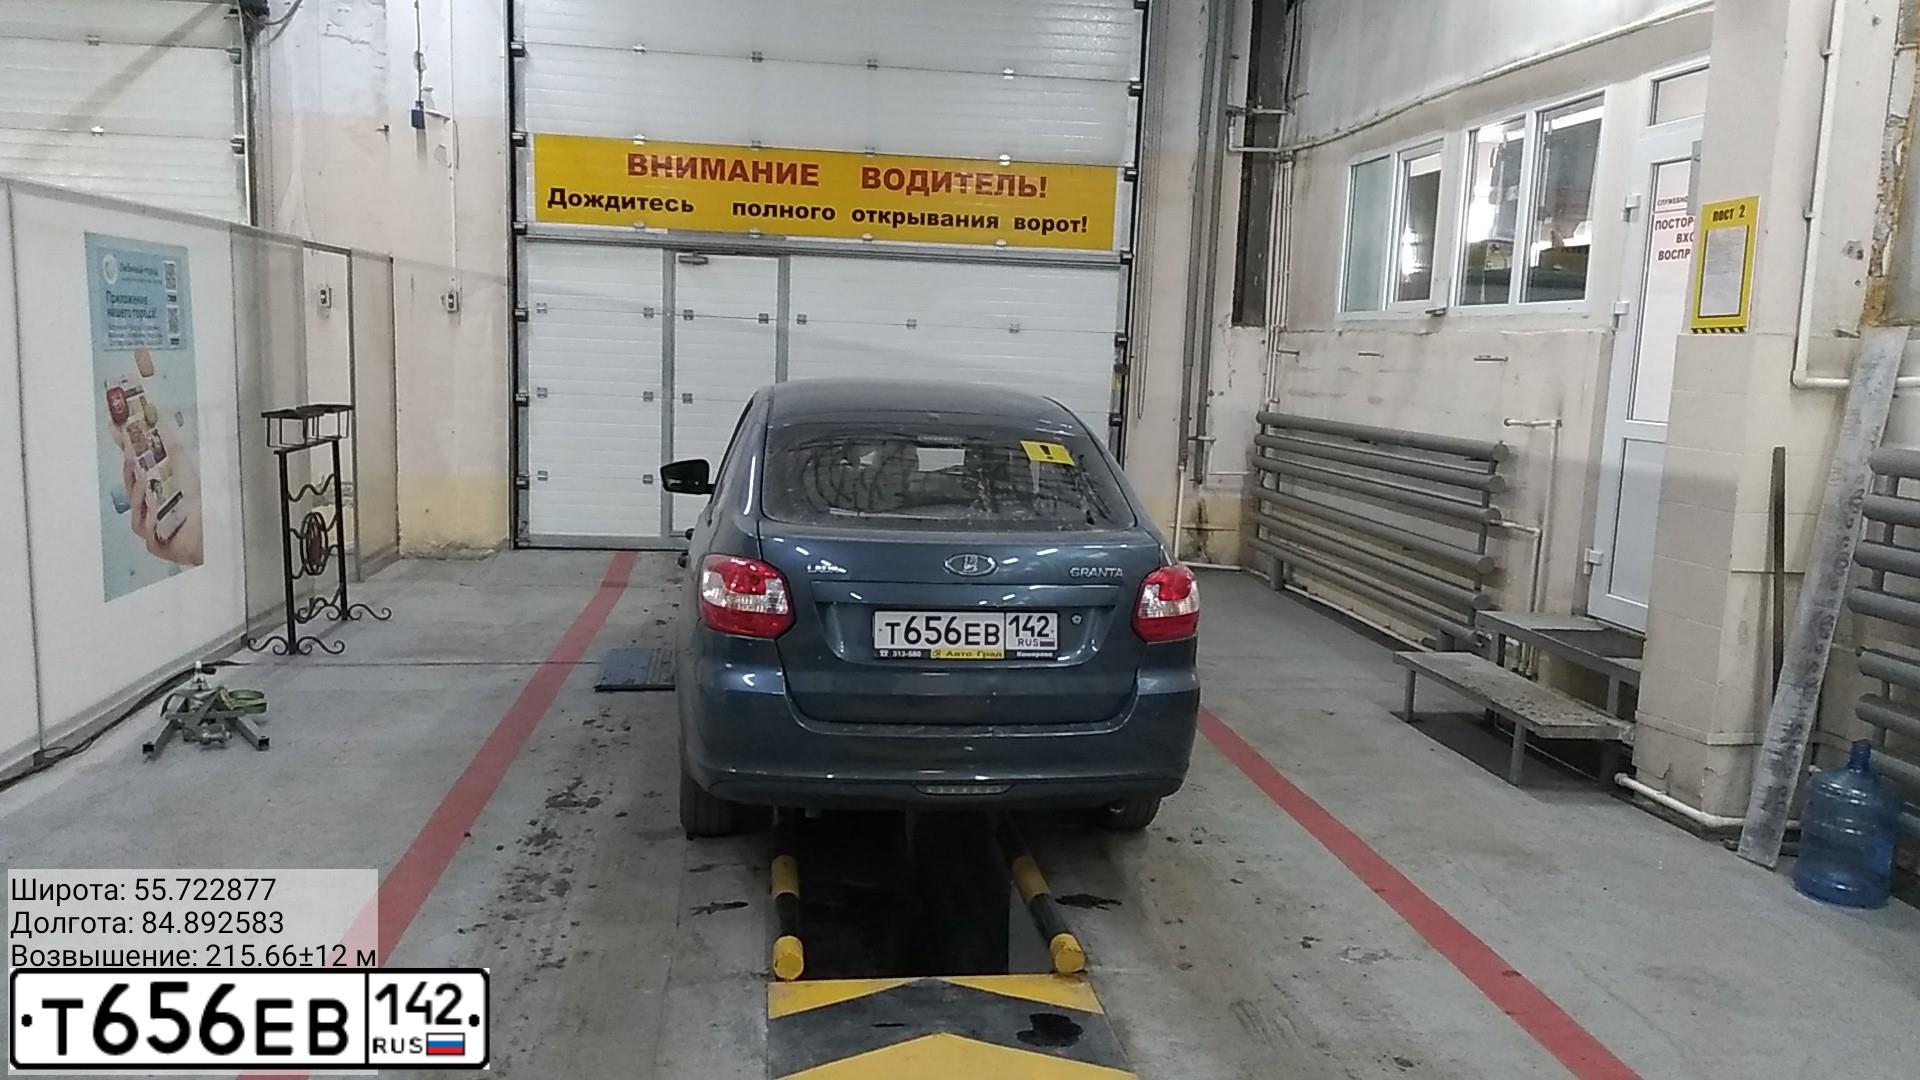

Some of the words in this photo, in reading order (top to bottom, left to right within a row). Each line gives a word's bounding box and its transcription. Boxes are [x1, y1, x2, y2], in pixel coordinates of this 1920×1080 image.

[627, 153, 820, 187] ВНИМАНИЕ
[861, 166, 1048, 198] ВОДИТЕЛЬ!
[547, 187, 695, 214] Дождитесь
[732, 202, 836, 222] полного
[851, 207, 1000, 230] открывания
[1013, 215, 1089, 236] ворот!
[1712, 208, 1735, 222] ПОСТ
[1738, 204, 1746, 219] 2
[1654, 216, 1694, 231] ПОСТОР
[1658, 248, 1691, 261] ВОСПР
[1070, 567, 1123, 577] GRANTA
[885, 615, 1000, 646] Т656ЕВ
[1008, 615, 1050, 638] 142
[1017, 638, 1039, 647] RUS
